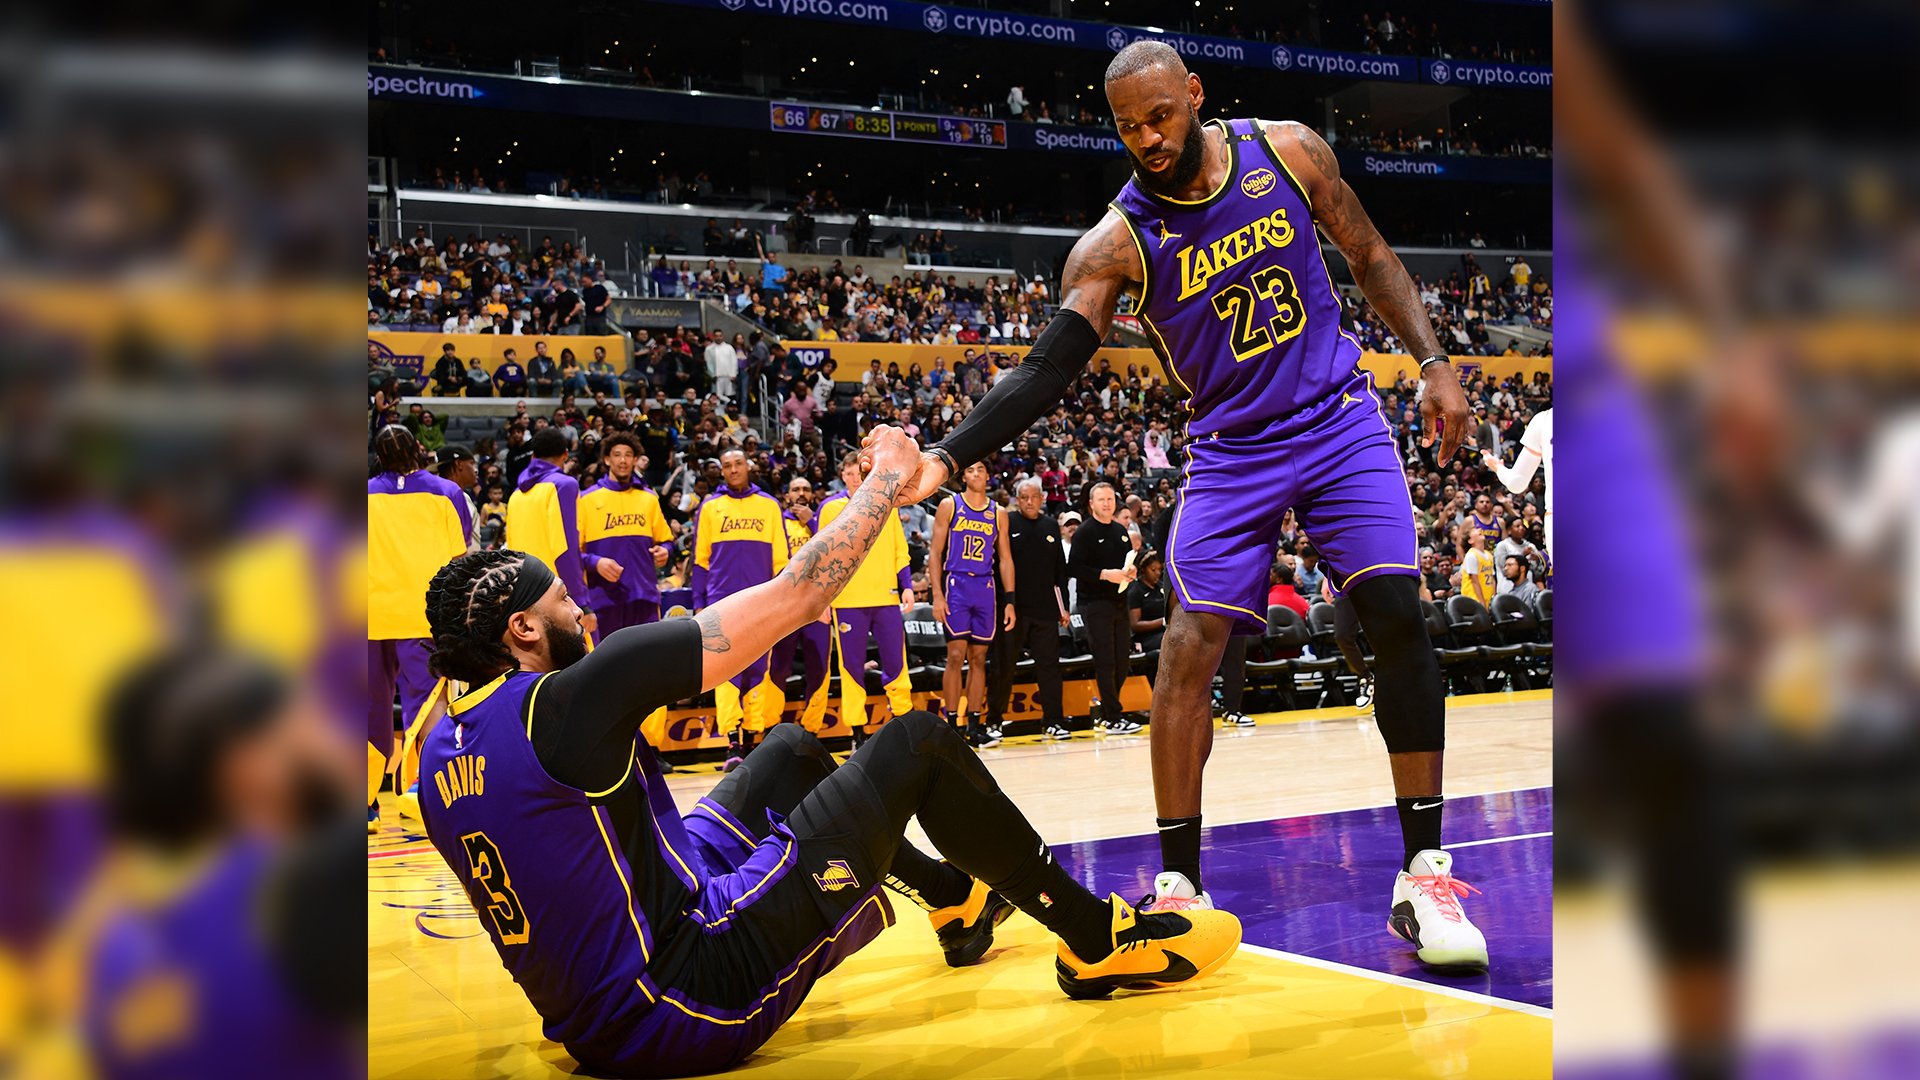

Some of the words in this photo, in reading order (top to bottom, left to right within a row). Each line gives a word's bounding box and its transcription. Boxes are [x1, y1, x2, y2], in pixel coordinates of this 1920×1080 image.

[953, 14, 1076, 42] crypto.com
[1134, 35, 1244, 61] pto.com
[1297, 53, 1399, 76] crypto.com
[1455, 66, 1553, 85] crypto.com
[784, 110, 805, 127] 66
[820, 113, 840, 129] 67
[855, 116, 890, 133] 8:35
[903, 121, 937, 133] POINTS
[1035, 129, 1118, 151] Spectrum
[1364, 156, 1438, 176] Spectrum
[1243, 173, 1273, 192] bibigo
[1176, 208, 1295, 302] LAKERS
[1211, 264, 1308, 363] 23
[795, 350, 825, 367] 101
[604, 512, 646, 531] LAKERS
[720, 515, 765, 533] LAKERS
[952, 516, 994, 536] LAKERS
[962, 534, 986, 562] 12
[904, 620, 920, 634] GET
[919, 621, 937, 635] THE
[434, 754, 486, 809] DAVIS
[460, 830, 531, 946] 3
